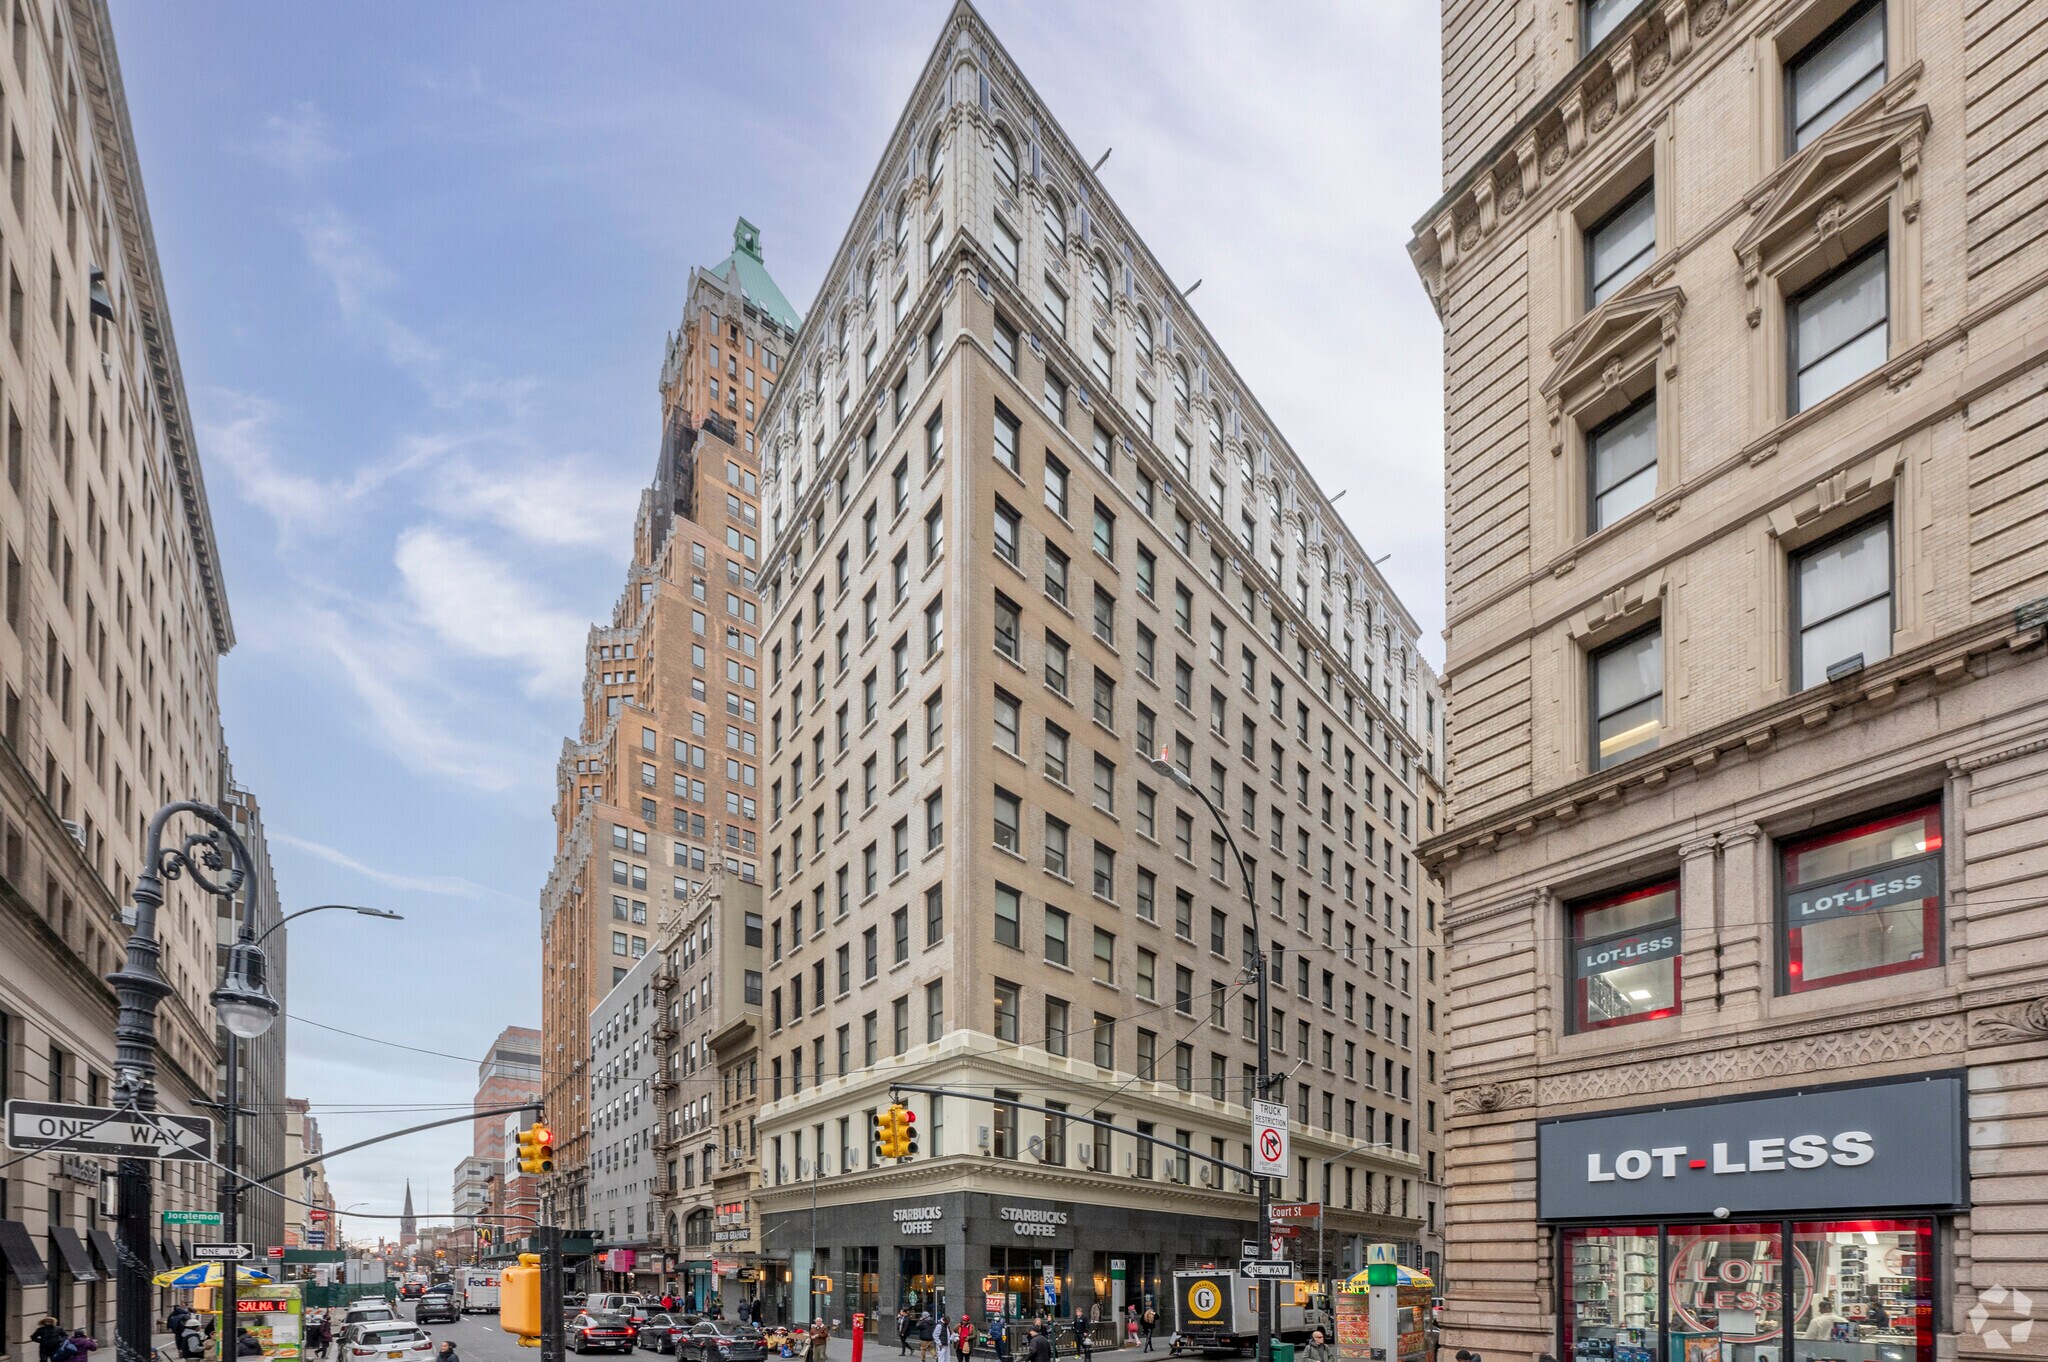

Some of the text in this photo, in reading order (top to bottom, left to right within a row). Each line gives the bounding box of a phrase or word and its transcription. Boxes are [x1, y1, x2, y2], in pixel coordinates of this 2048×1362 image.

[1801, 874, 1922, 915] LOT-LESS
[1586, 936, 1674, 967] LOT-LESS
[1260, 1103, 1282, 1116] TRUCK
[1255, 1114, 1287, 1127] RESTRICTION
[39, 1118, 185, 1145] ONE WAY
[1588, 1131, 1875, 1182] LOT-LESS
[168, 1212, 220, 1220] Joralemon
[893, 1206, 942, 1222] STARBUCKS
[1001, 1206, 1067, 1225] STARBUCKS
[1272, 1206, 1302, 1217] Court St
[901, 1220, 933, 1235] COFFEE
[1014, 1222, 1056, 1237] COFFEE
[1270, 1226, 1291, 1234] oralemon
[1247, 1265, 1286, 1274] ONE WAY
[1694, 1258, 1782, 1284] LOT
[468, 1277, 501, 1287] FedEx
[1045, 1276, 1054, 1284] 20
[1198, 1290, 1211, 1308] G
[1695, 1291, 1782, 1311] LESS
[1853, 1305, 1862, 1315] 3
